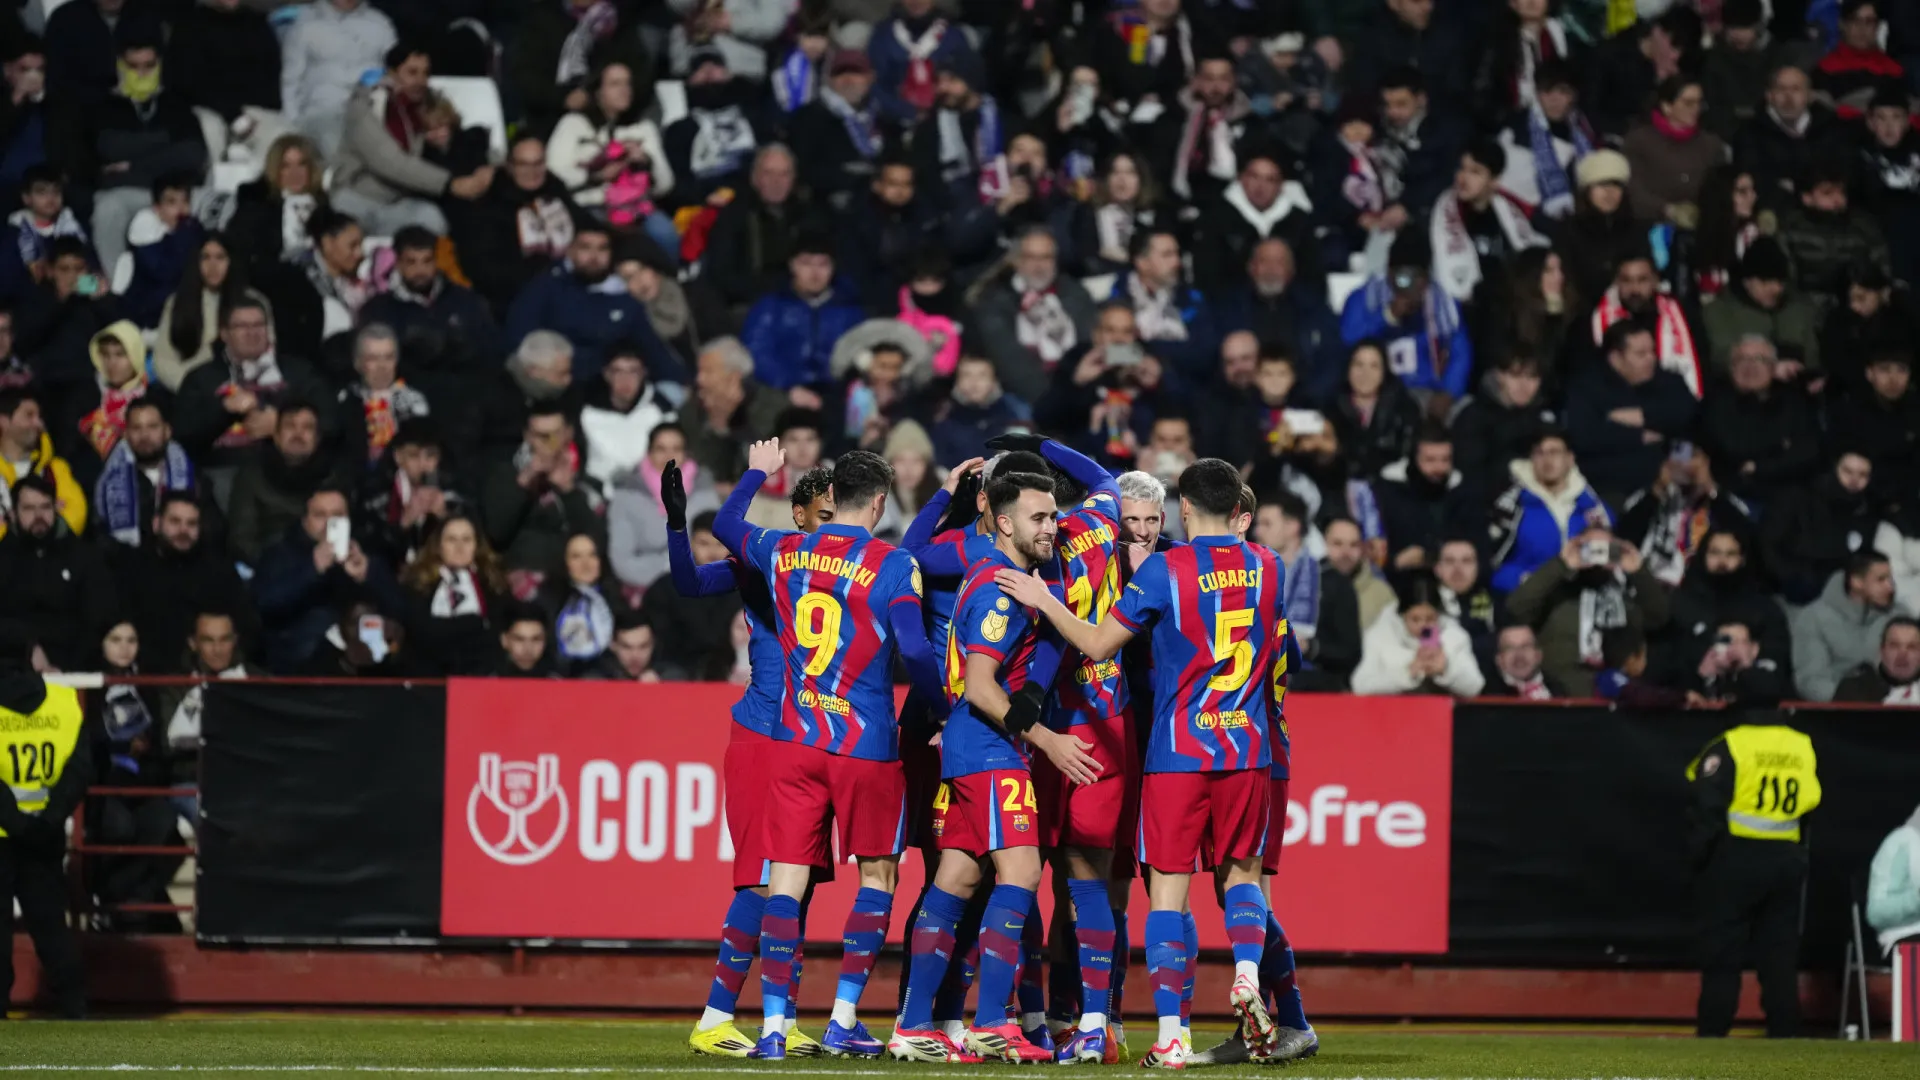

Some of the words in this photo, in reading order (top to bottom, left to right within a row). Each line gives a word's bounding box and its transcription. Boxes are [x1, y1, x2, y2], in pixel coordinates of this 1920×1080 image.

[777, 551, 877, 588] LEWANDOWSKI
[795, 592, 842, 676] 9
[1206, 608, 1255, 692] 5
[8, 741, 55, 784] 120
[578, 759, 736, 862] COP
[1000, 777, 1038, 814] 24
[1756, 775, 1799, 815] 118
